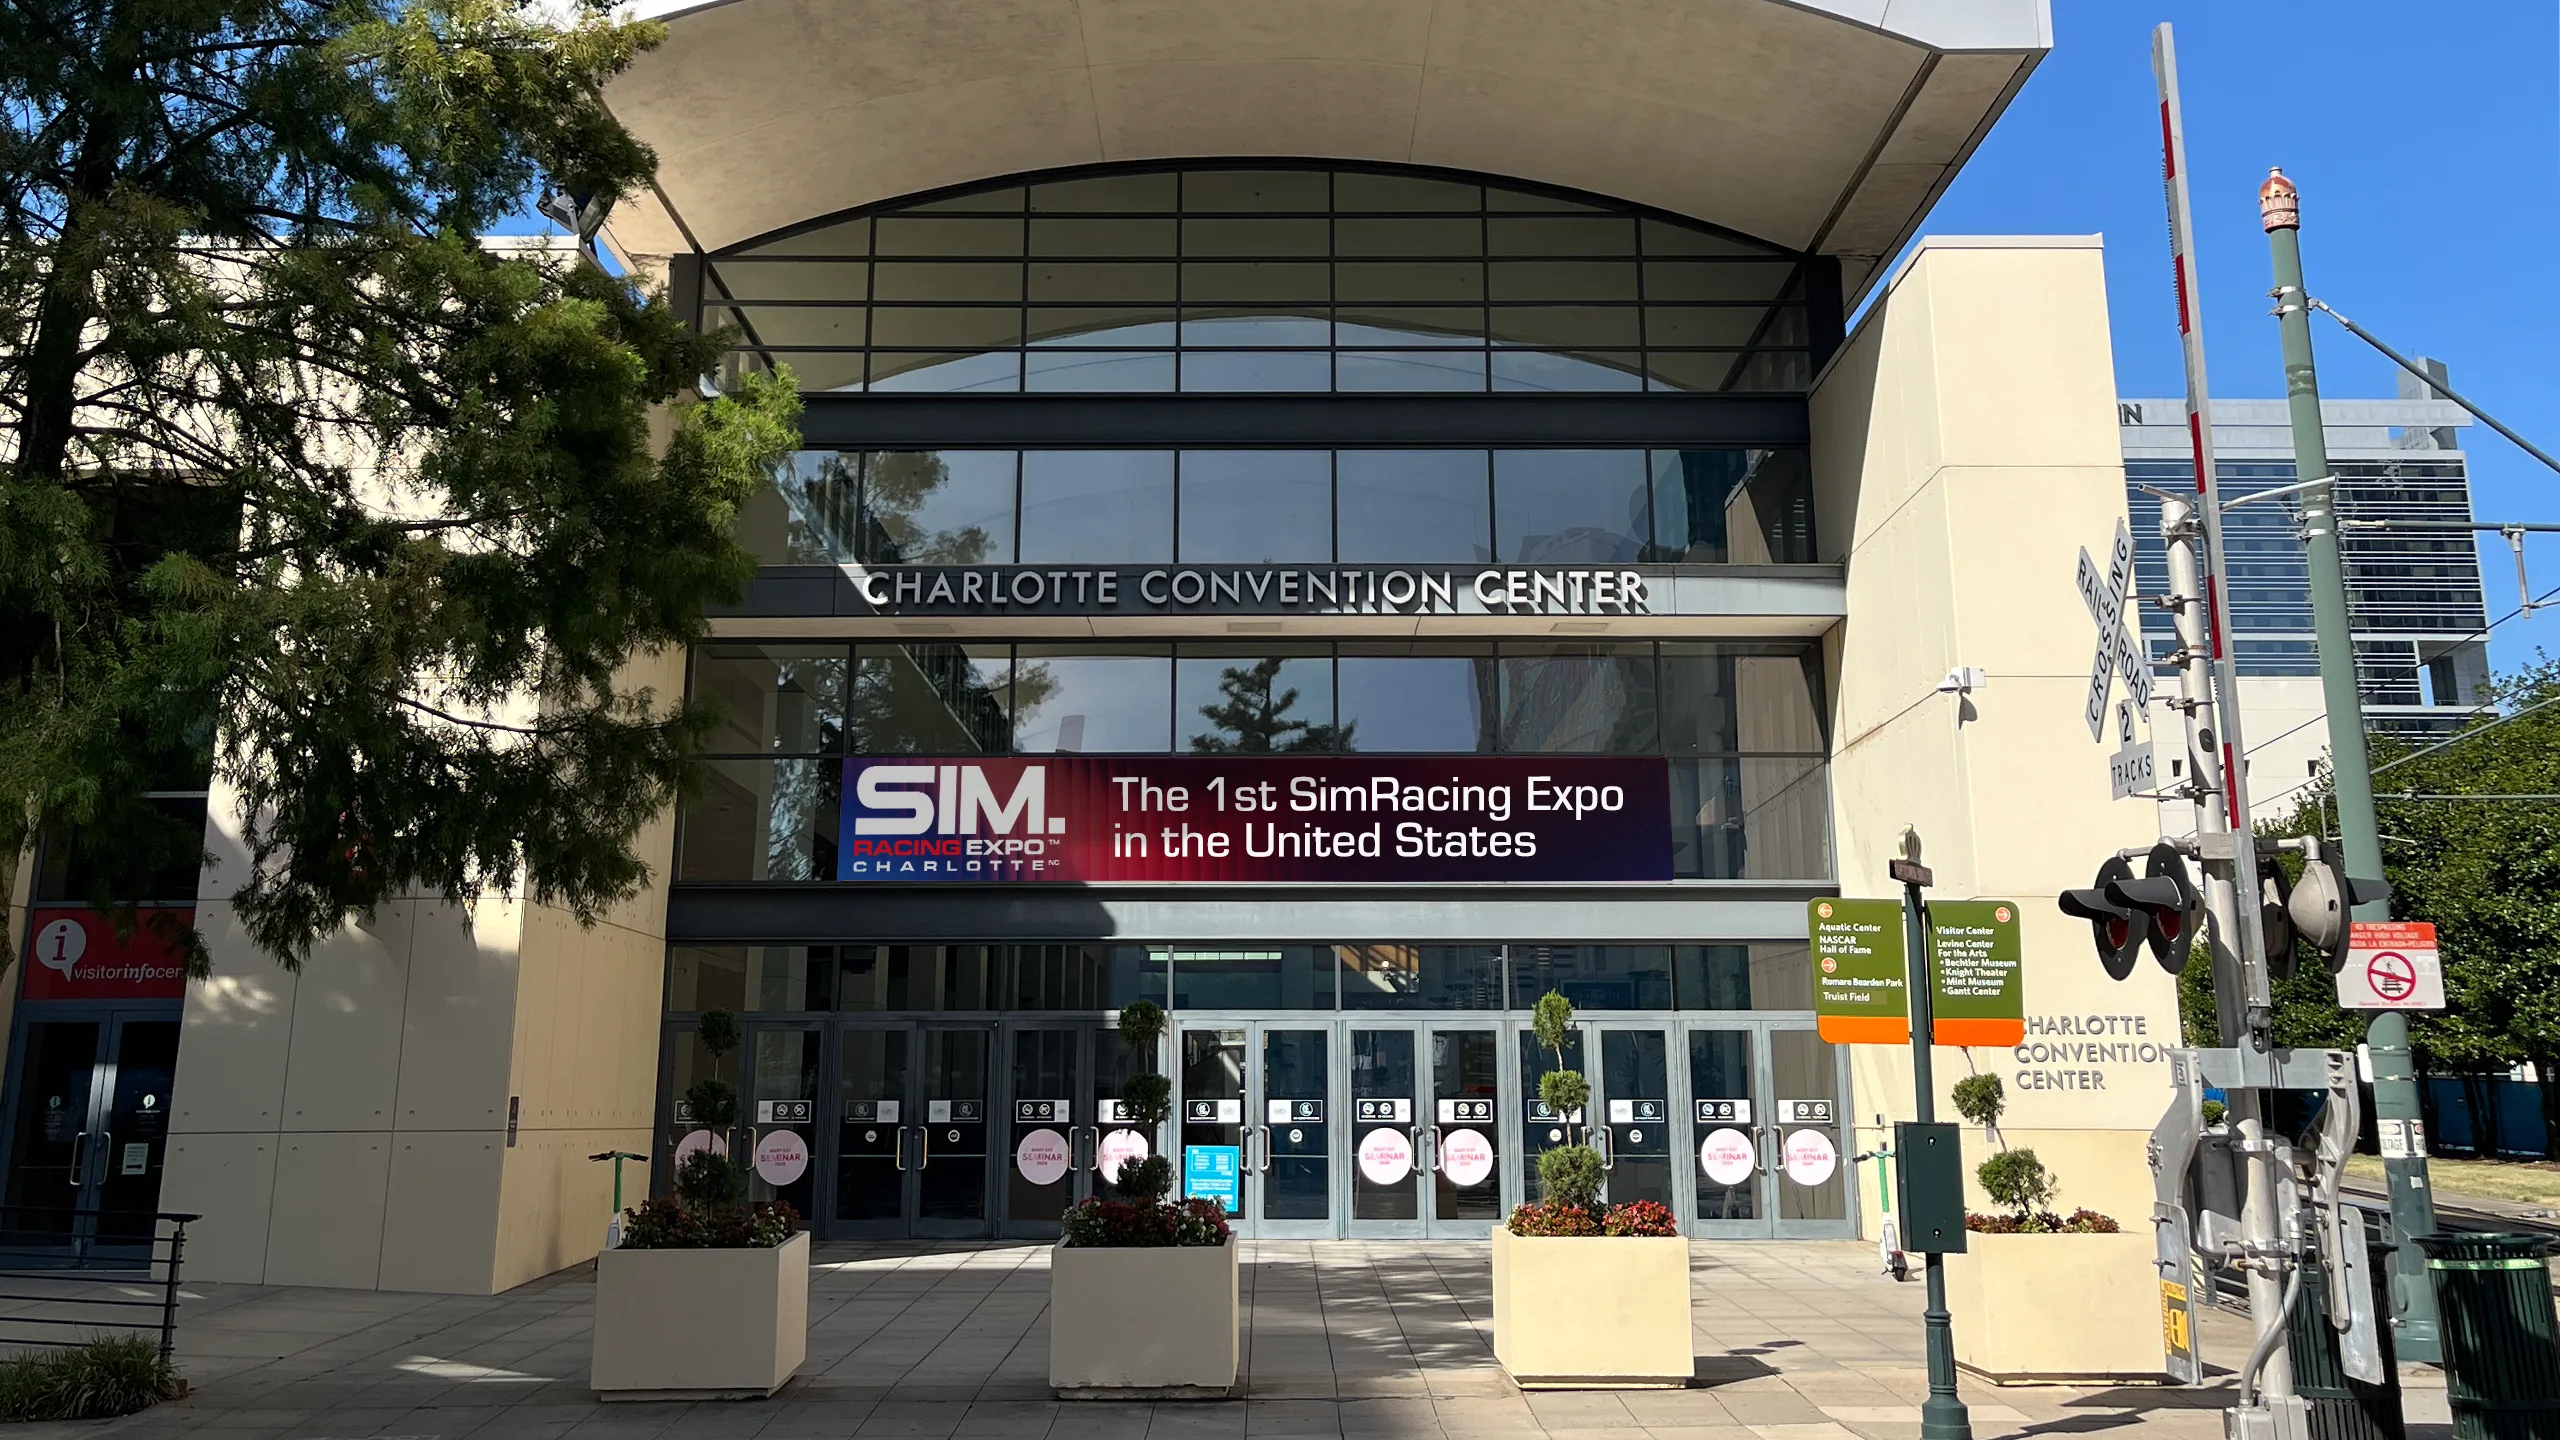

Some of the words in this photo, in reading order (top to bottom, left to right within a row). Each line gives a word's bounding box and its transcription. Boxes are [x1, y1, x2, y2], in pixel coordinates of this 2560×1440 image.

[862, 570, 1117, 605] CHARLOTTE
[1140, 570, 1452, 604] CONVENTION
[1474, 570, 1644, 604] CENTER
[2078, 558, 2102, 622] RAIL
[2117, 640, 2148, 709] ROAD
[2090, 537, 2128, 722] CROSSING
[2122, 706, 2132, 742] 2
[2111, 753, 2152, 789] TRACKS
[855, 766, 1065, 835] SIM.
[1112, 776, 1188, 811] The
[1206, 776, 1277, 811] 1st
[1290, 776, 1510, 821] SimRacing
[1527, 776, 1624, 820] Expo
[1113, 823, 1147, 857] in
[1162, 823, 1230, 857] the
[1246, 822, 1381, 857] United
[1396, 822, 1536, 857] States
[854, 840, 960, 856] RACING
[853, 861, 1044, 872] CHARLOTTE
[1819, 922, 1851, 932] Aquatic
[1853, 923, 1881, 932] Center
[1936, 926, 1964, 934] Visitor
[1966, 926, 1994, 934] Center
[1820, 935, 1856, 944] NASCAR
[1966, 940, 1994, 948] Center
[1820, 945, 1836, 953] Hall
[1839, 945, 1847, 953] of
[1850, 946, 1871, 954] Fame
[1938, 949, 1951, 957] For
[1981, 959, 2016, 967] Museum
[1946, 968, 1973, 977] Knight
[1975, 968, 2007, 976] Theater
[1886, 978, 1903, 987] Park
[1968, 978, 2004, 986] Museum
[1947, 987, 1971, 995] Gantt
[1972, 987, 2000, 995] Center
[1823, 992, 1848, 1000] Truist
[1850, 993, 1870, 1001] Field
[2024, 1015, 2147, 1035] HARLOTTE
[2014, 1042, 2175, 1063] CONVENTION
[2016, 1070, 2106, 1090] CENTER
[761, 1154, 800, 1162] SEMINAR
